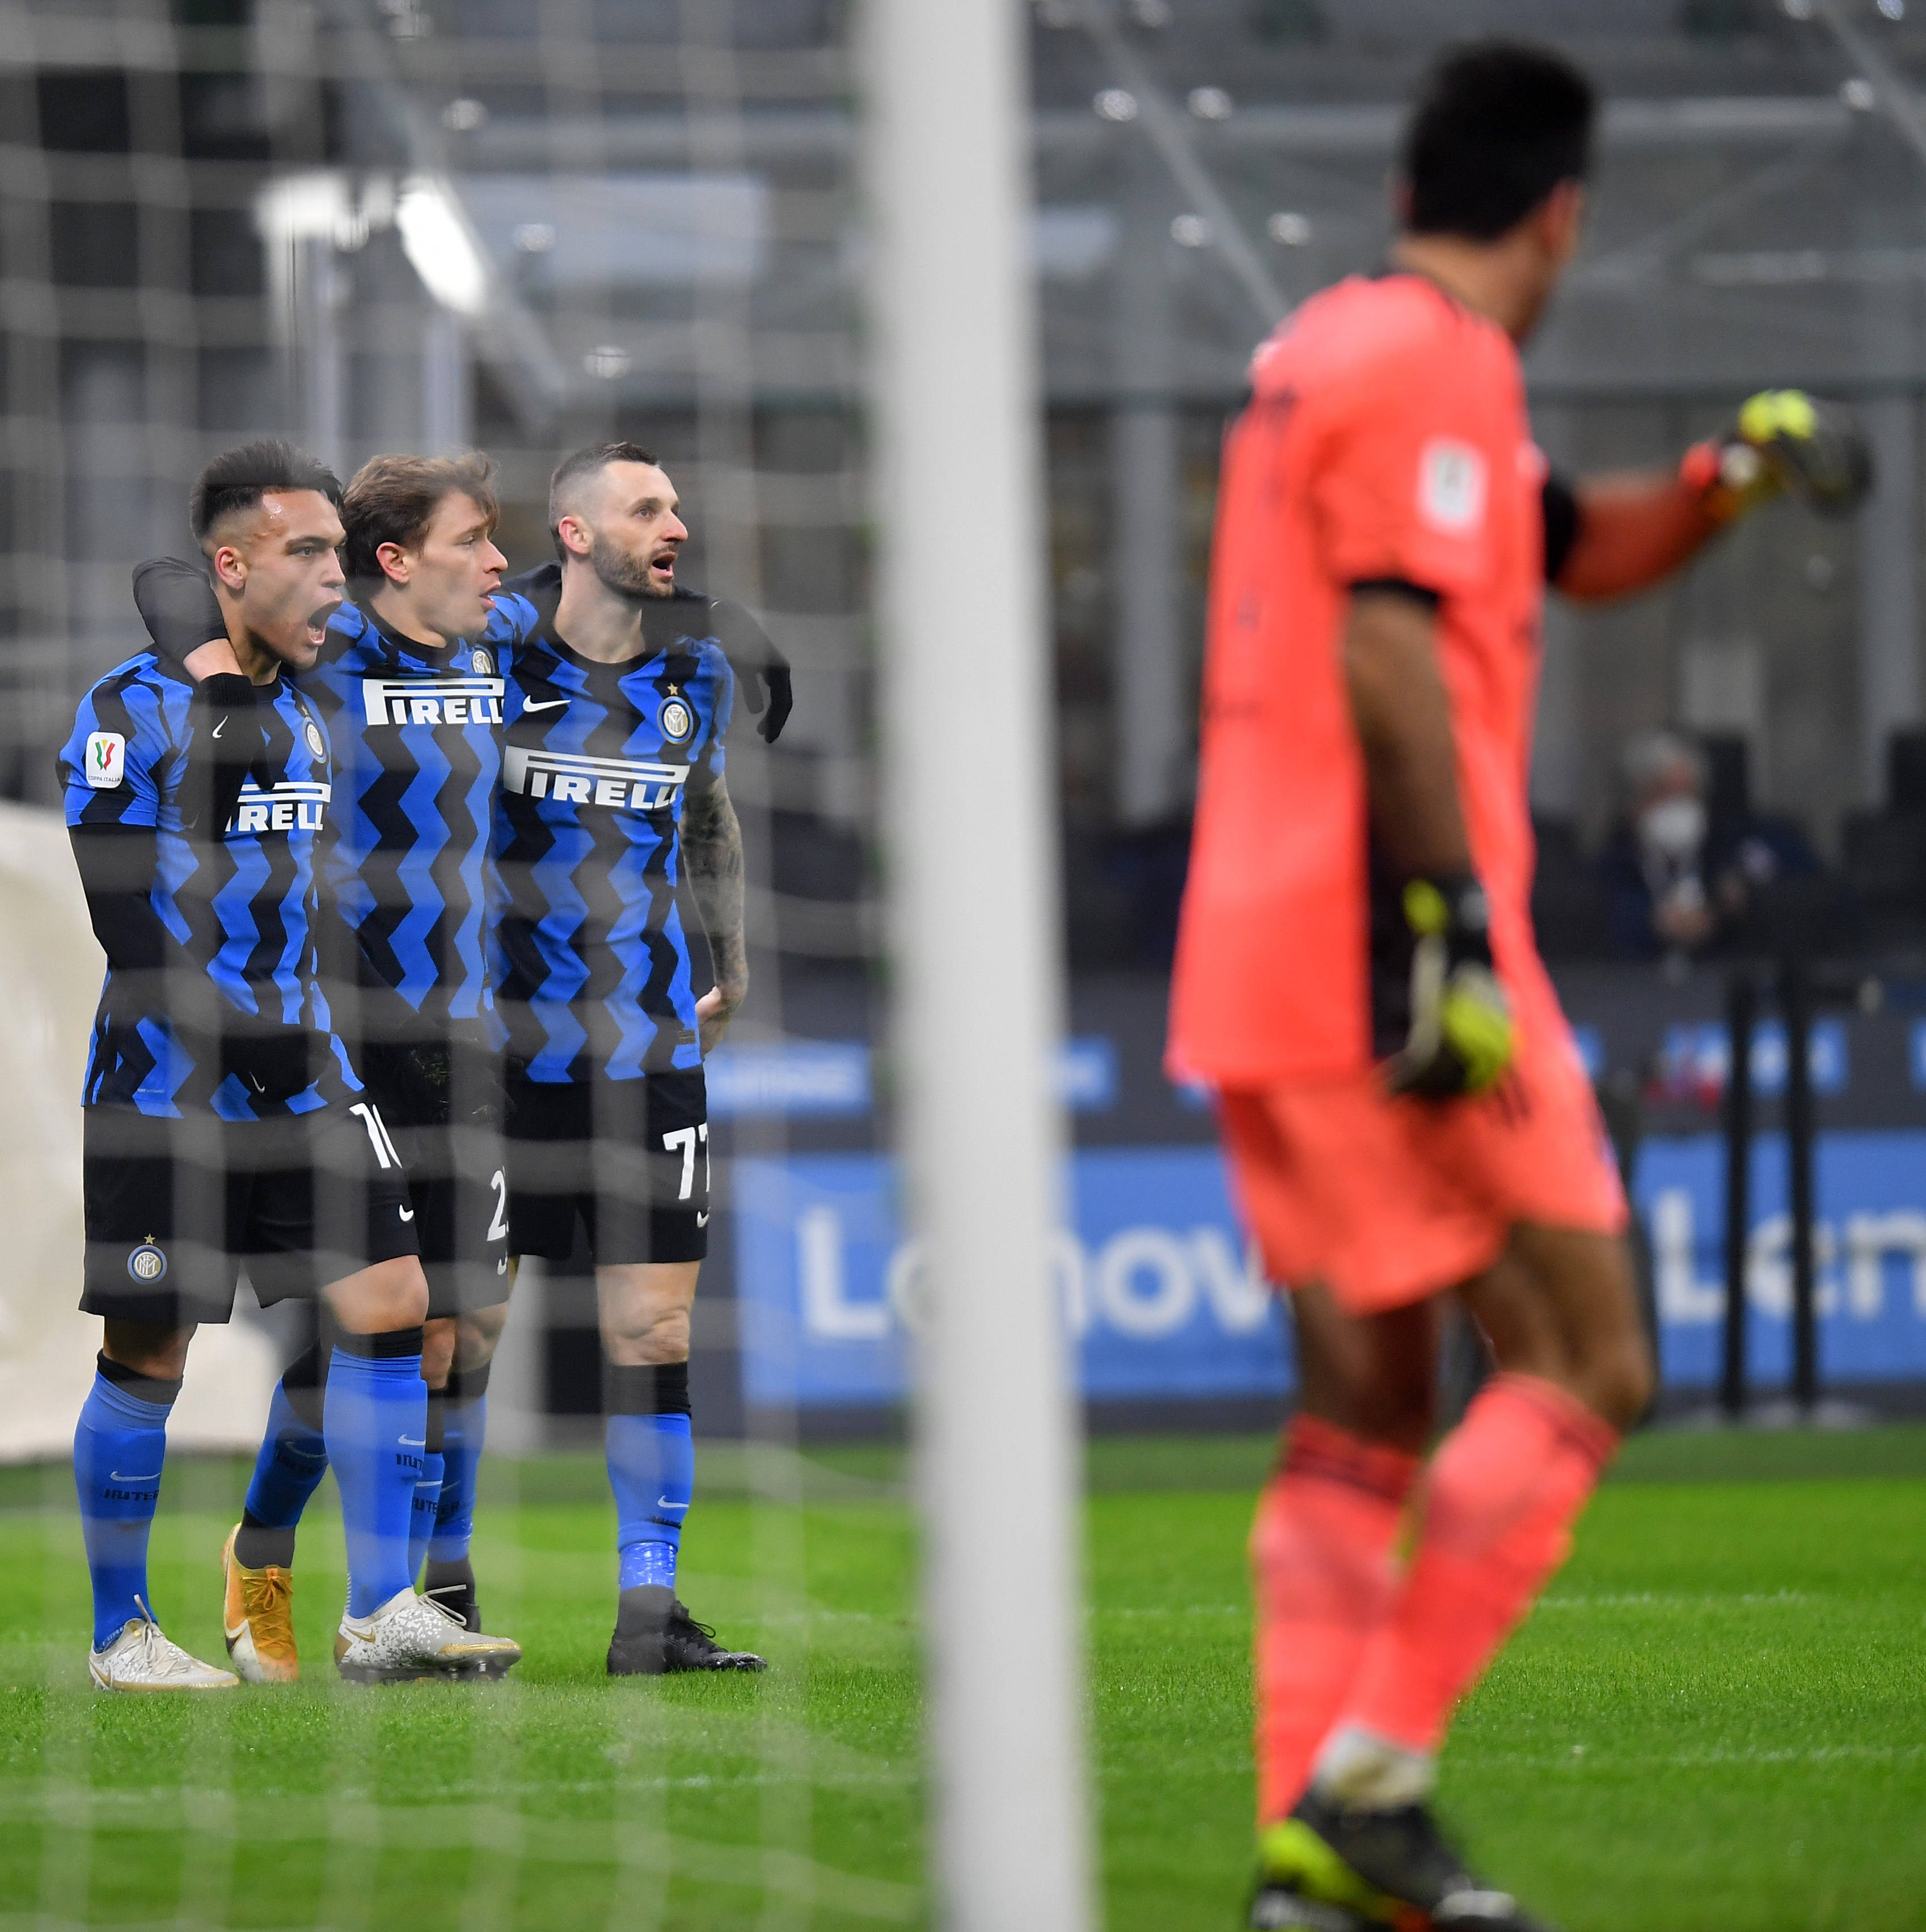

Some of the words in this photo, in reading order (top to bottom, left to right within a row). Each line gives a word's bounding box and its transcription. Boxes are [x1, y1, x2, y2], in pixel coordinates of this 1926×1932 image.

[363, 678, 505, 725] PIRELL
[349, 1102, 403, 1169] 1
[487, 1166, 509, 1241] 2
